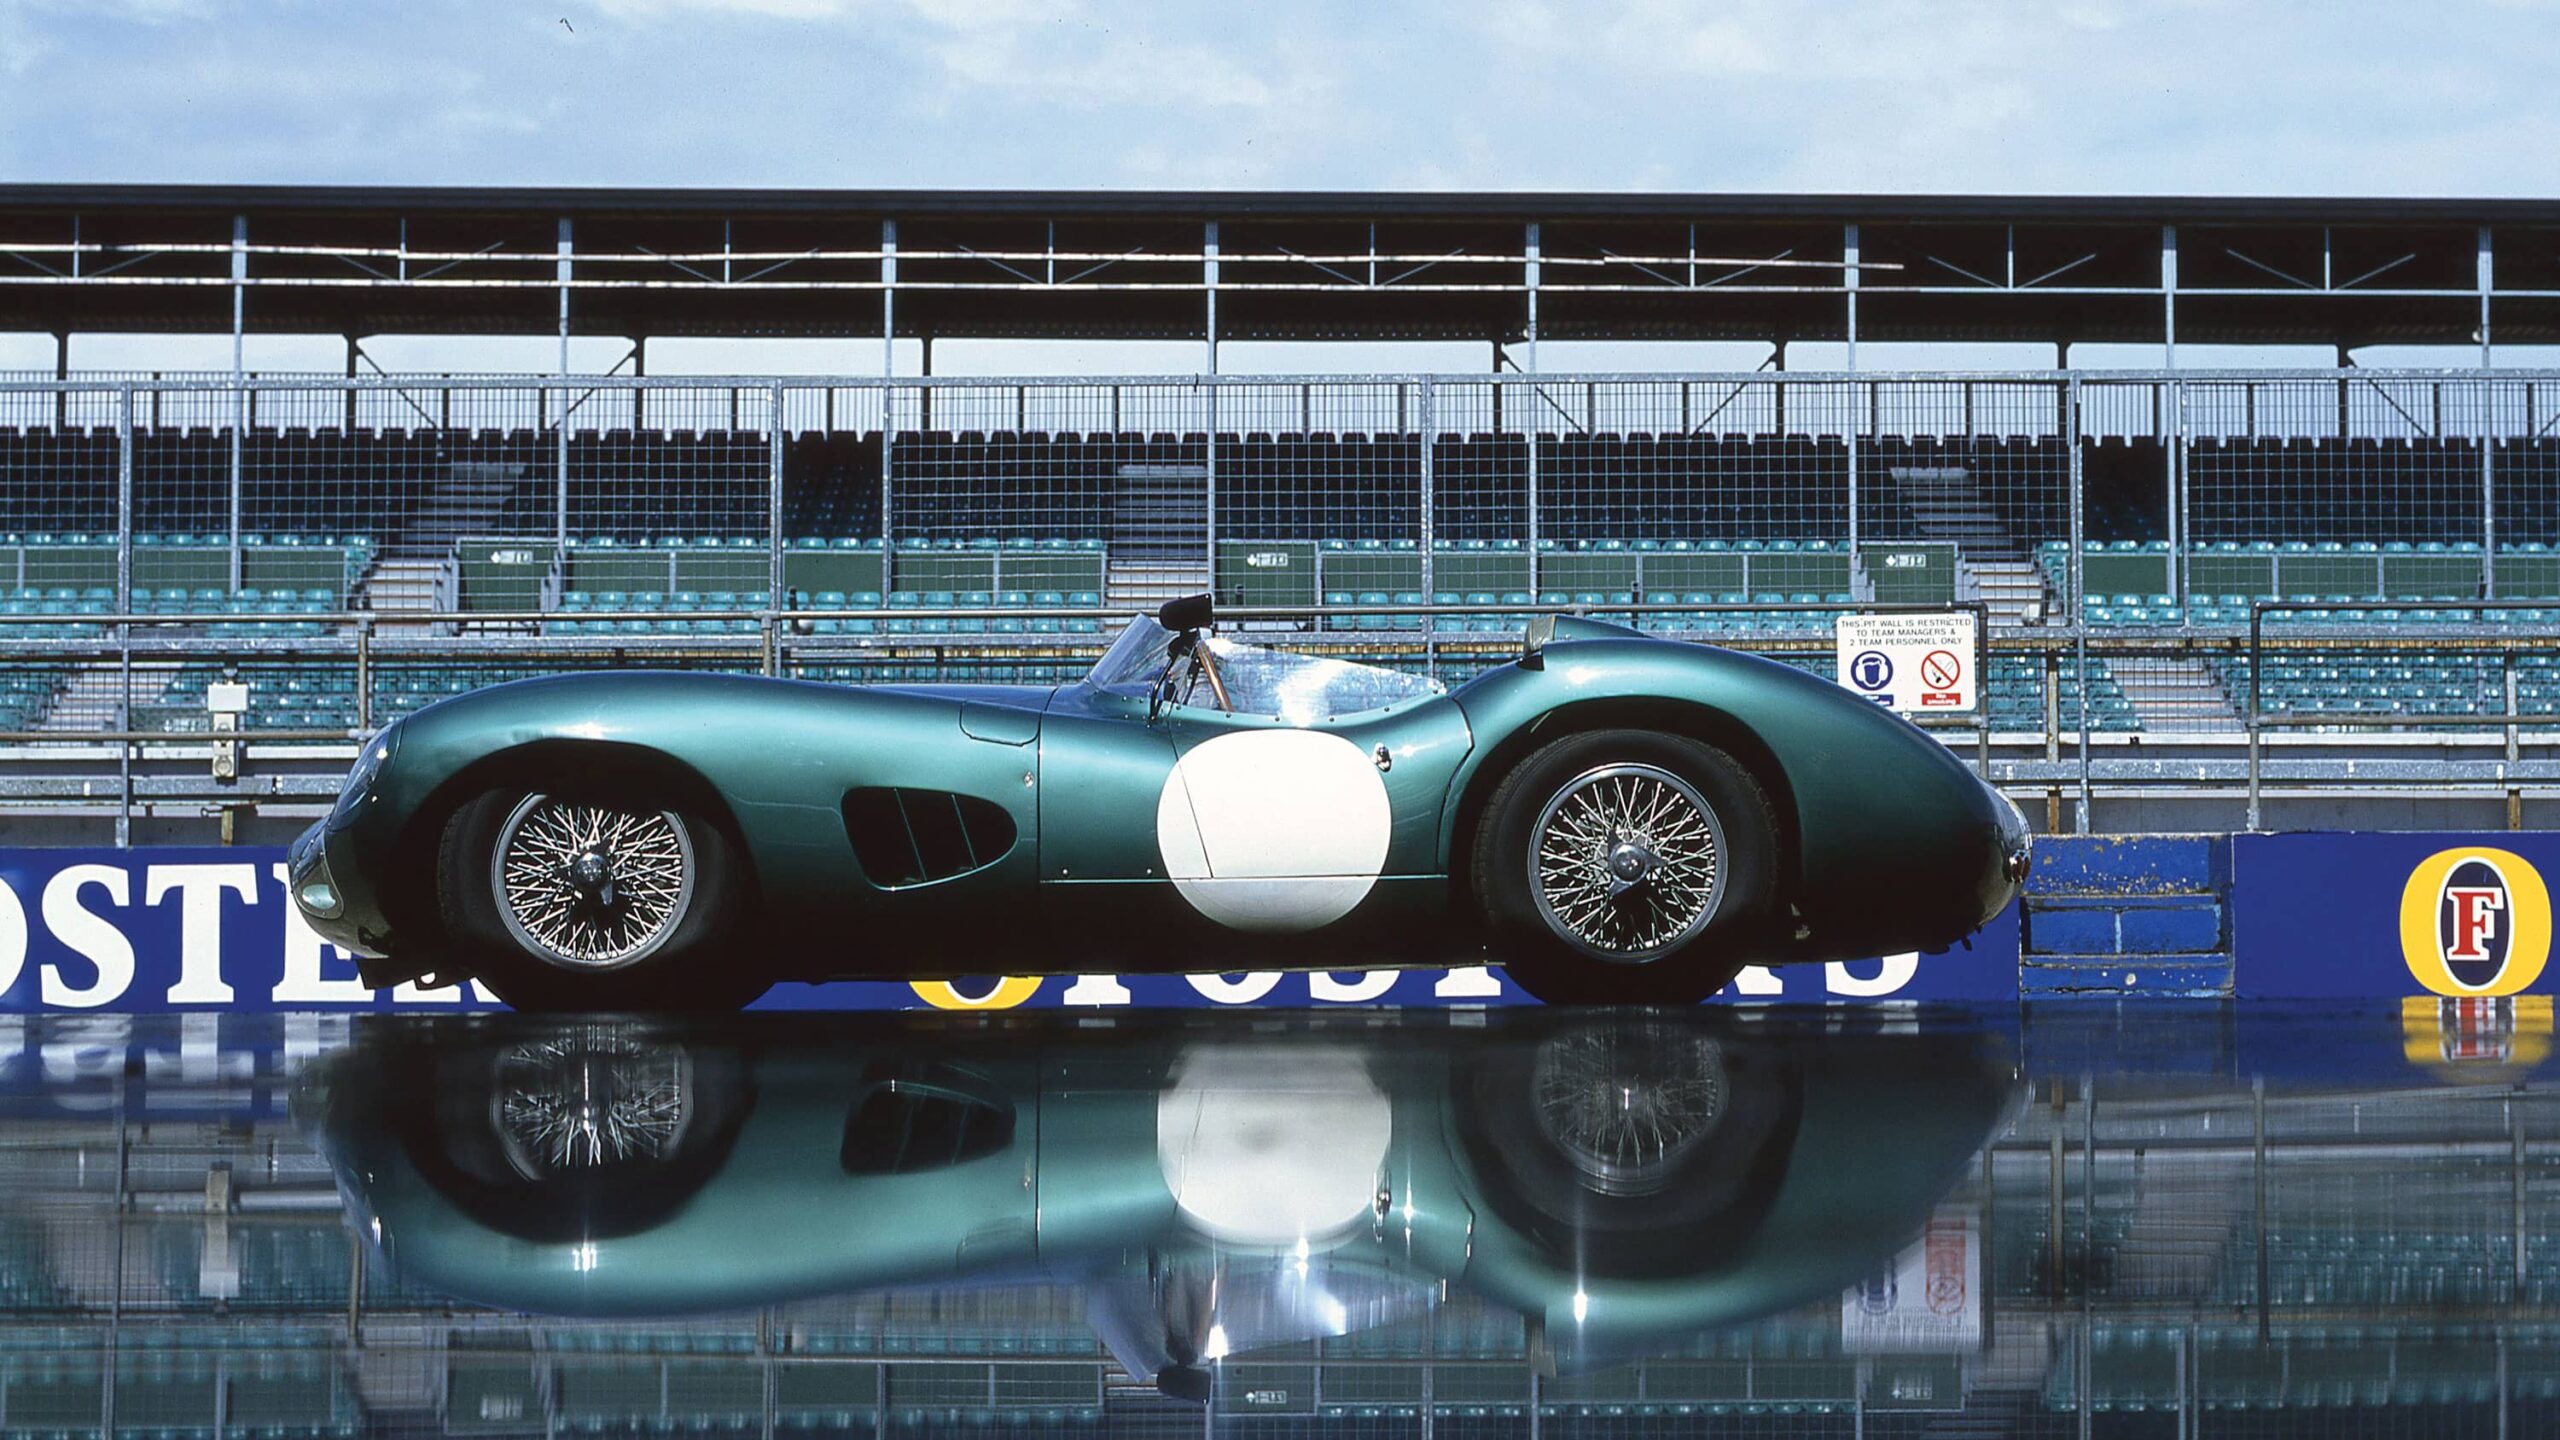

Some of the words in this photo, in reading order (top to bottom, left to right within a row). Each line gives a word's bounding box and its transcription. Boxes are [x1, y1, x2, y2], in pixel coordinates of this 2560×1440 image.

[1841, 620, 1859, 628] THIS
[1917, 619, 1971, 627] RESTRICTED
[1941, 637, 1962, 645] ONLY
[2447, 887, 2504, 961] F
